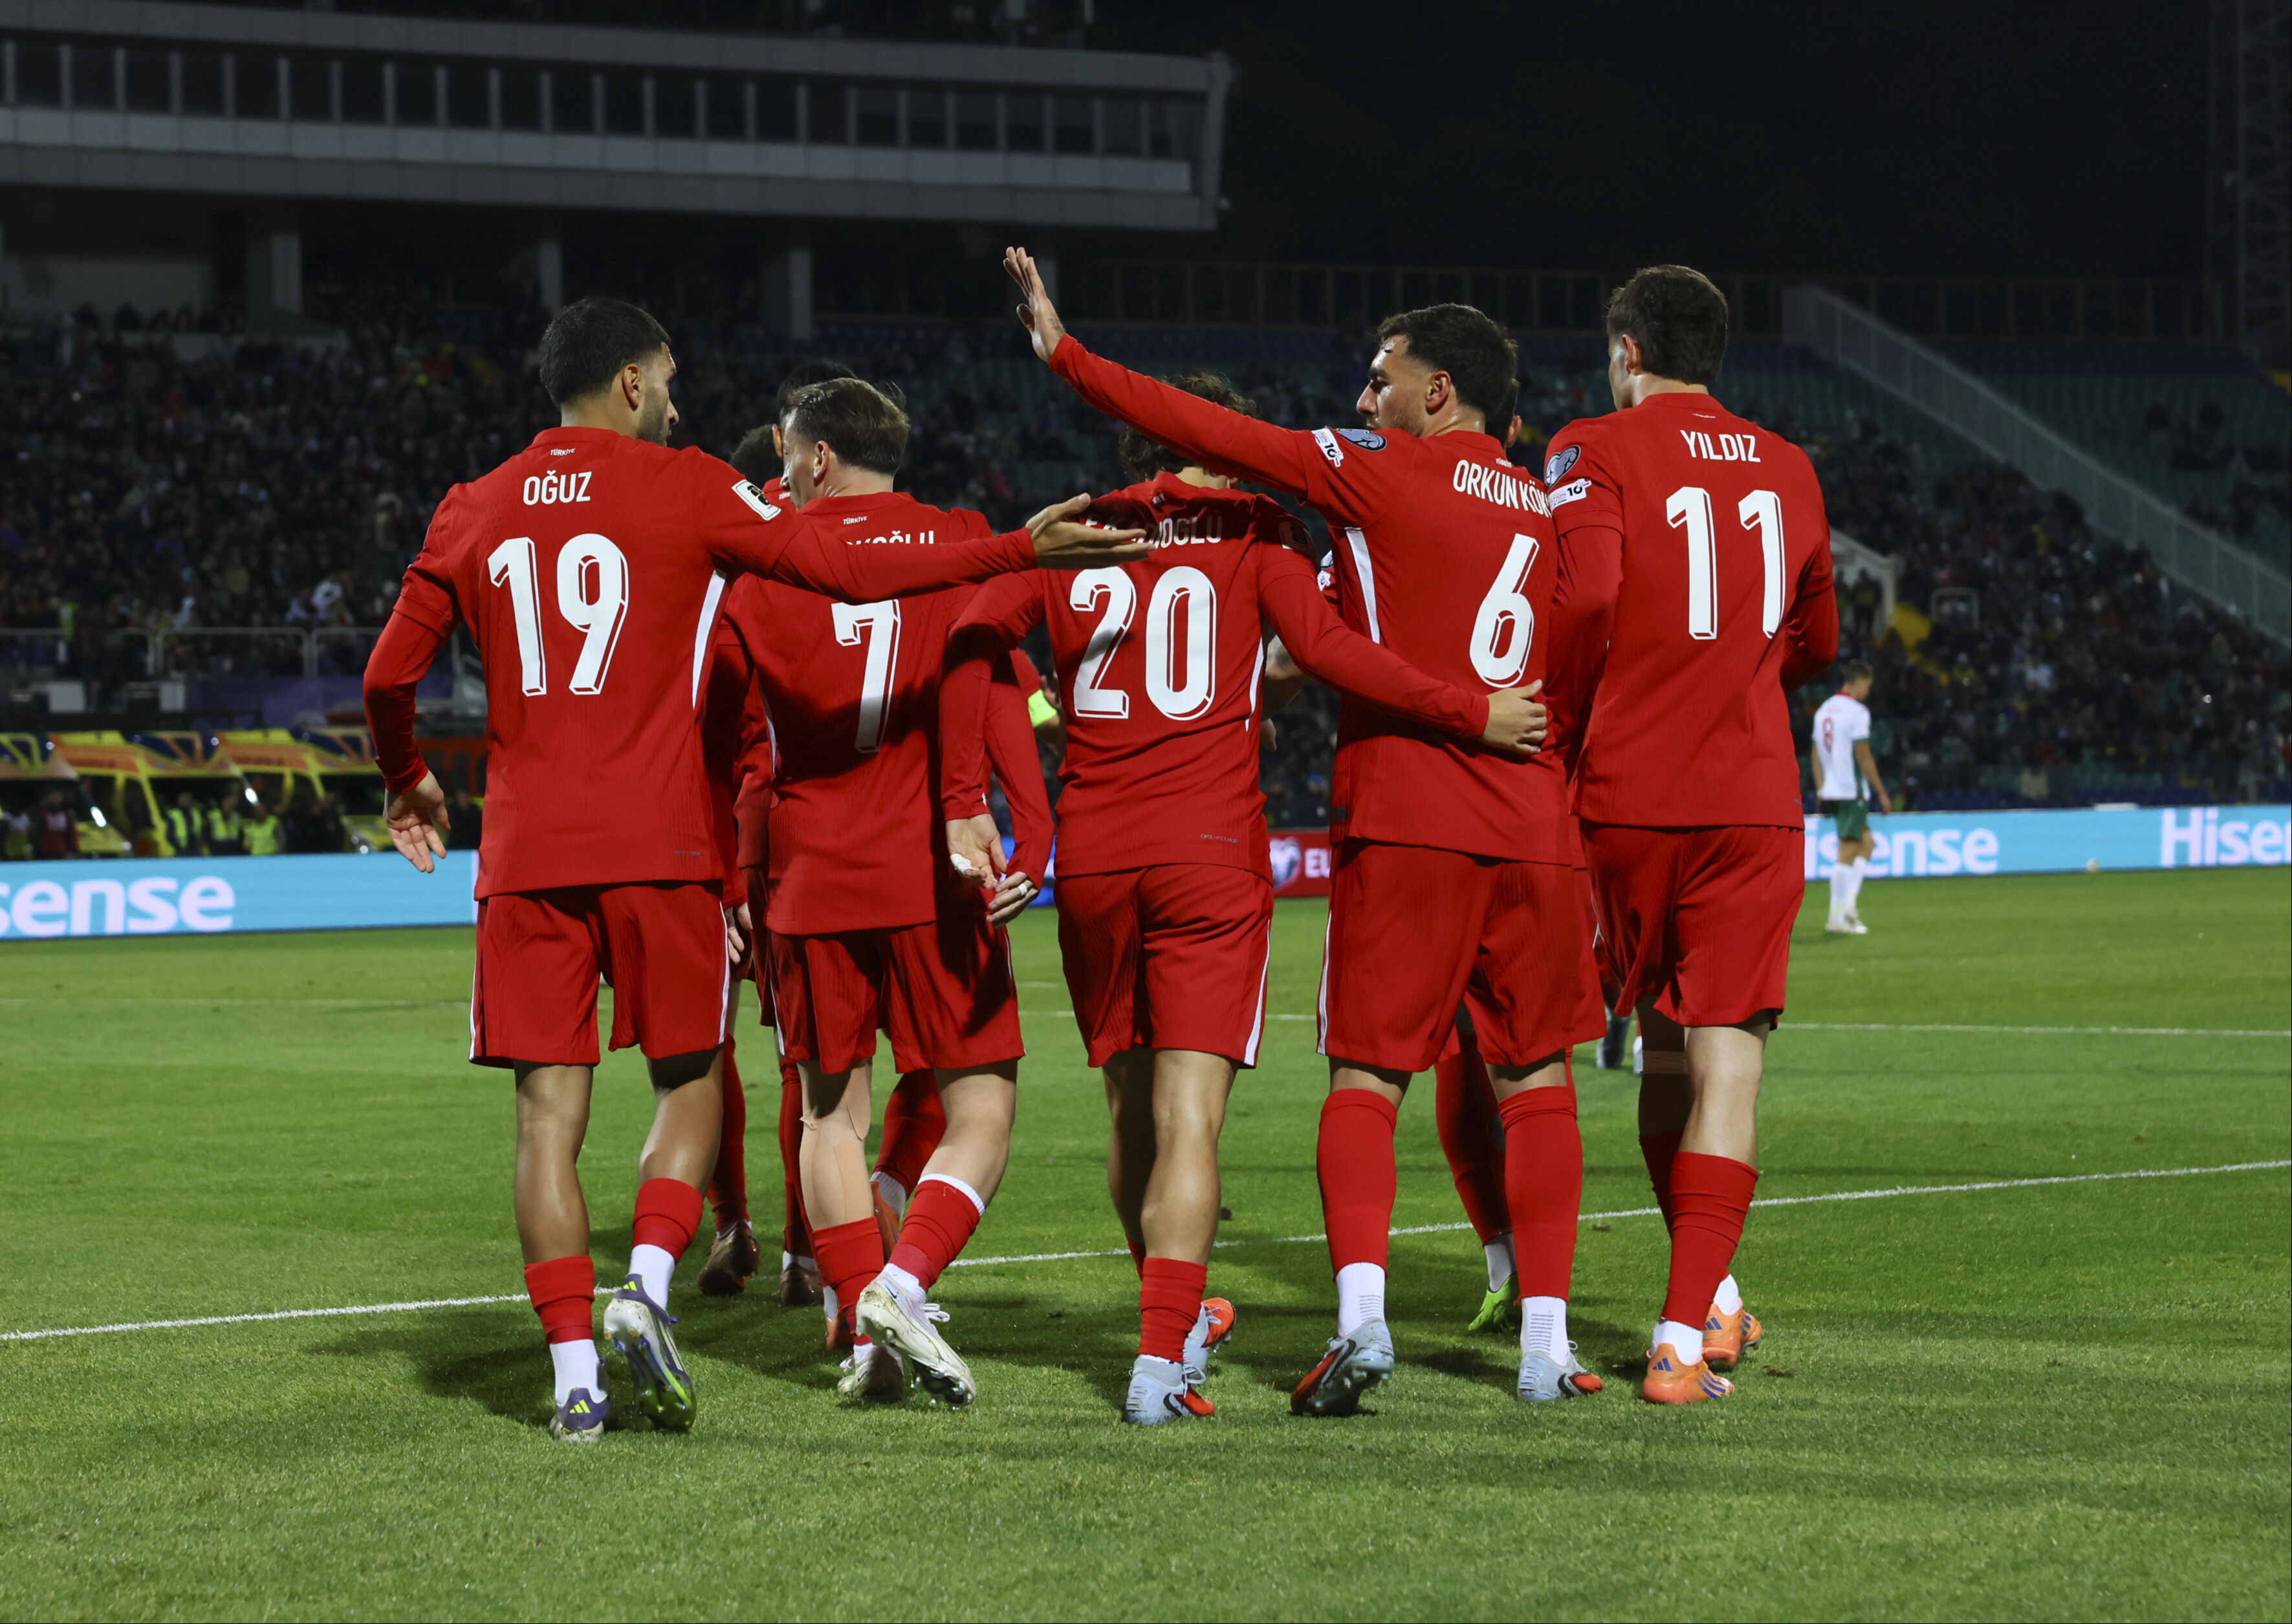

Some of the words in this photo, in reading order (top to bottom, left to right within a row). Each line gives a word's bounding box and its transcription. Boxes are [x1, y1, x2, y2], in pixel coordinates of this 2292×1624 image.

[523, 470, 592, 506] OĞUZ
[1453, 459, 1519, 510] ORKUN
[1519, 479, 1553, 519] KÖK
[1680, 429, 1761, 462] YILDIZ
[487, 533, 629, 697] 19
[1469, 533, 1540, 689] 6
[1666, 486, 1785, 640] 11
[831, 598, 901, 754] 7
[1069, 565, 1217, 720] 20
[1822, 717, 1834, 753] 8
[0, 875, 235, 937] ense
